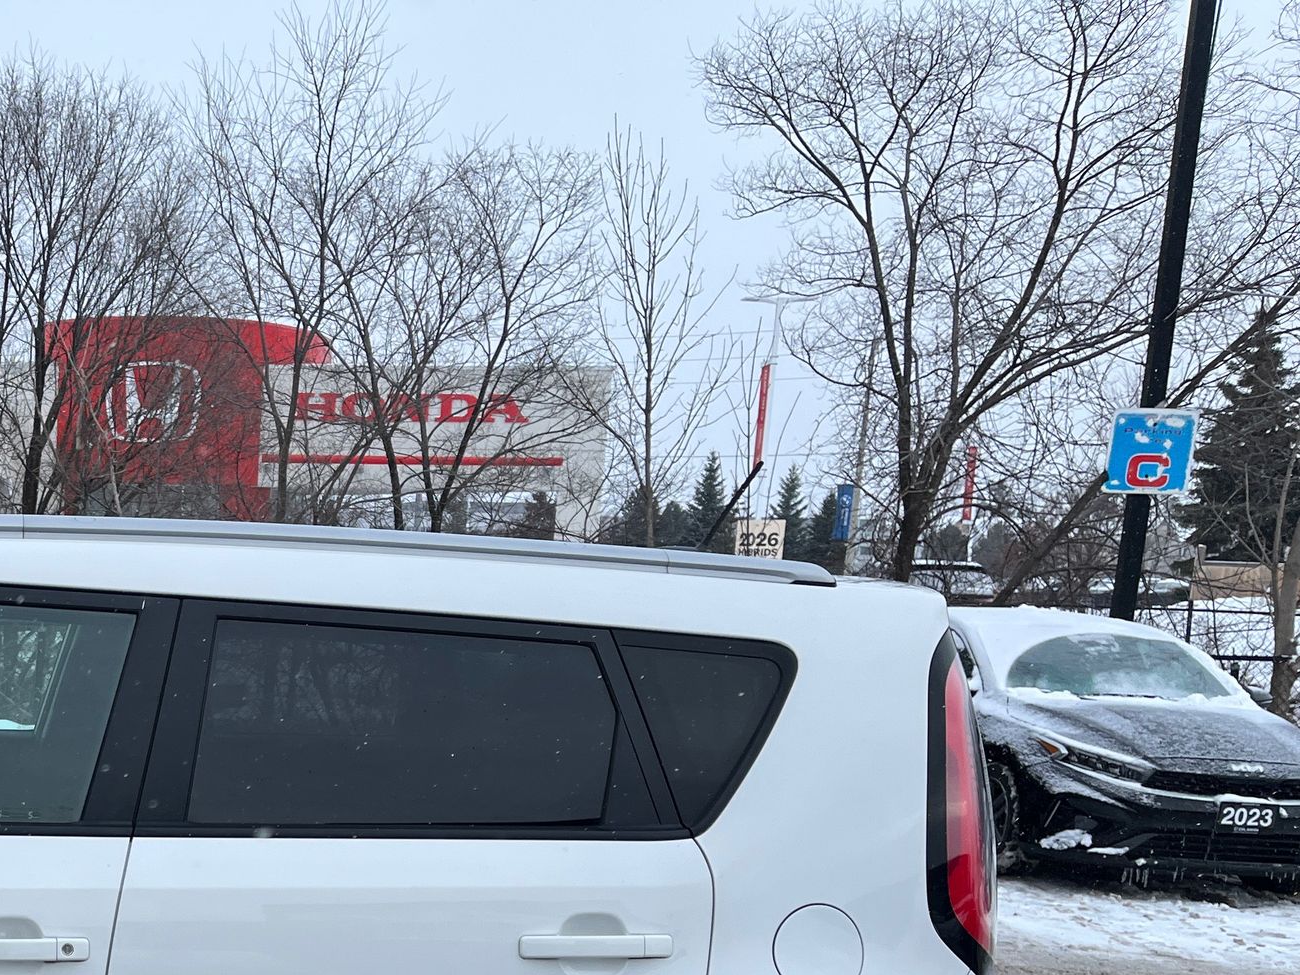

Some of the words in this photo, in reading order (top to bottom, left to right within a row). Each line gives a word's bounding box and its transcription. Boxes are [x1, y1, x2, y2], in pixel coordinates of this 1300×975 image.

[294, 392, 530, 424] HONDA
[1125, 454, 1171, 488] C
[739, 532, 780, 547] 2026
[1220, 806, 1273, 827] 2023
